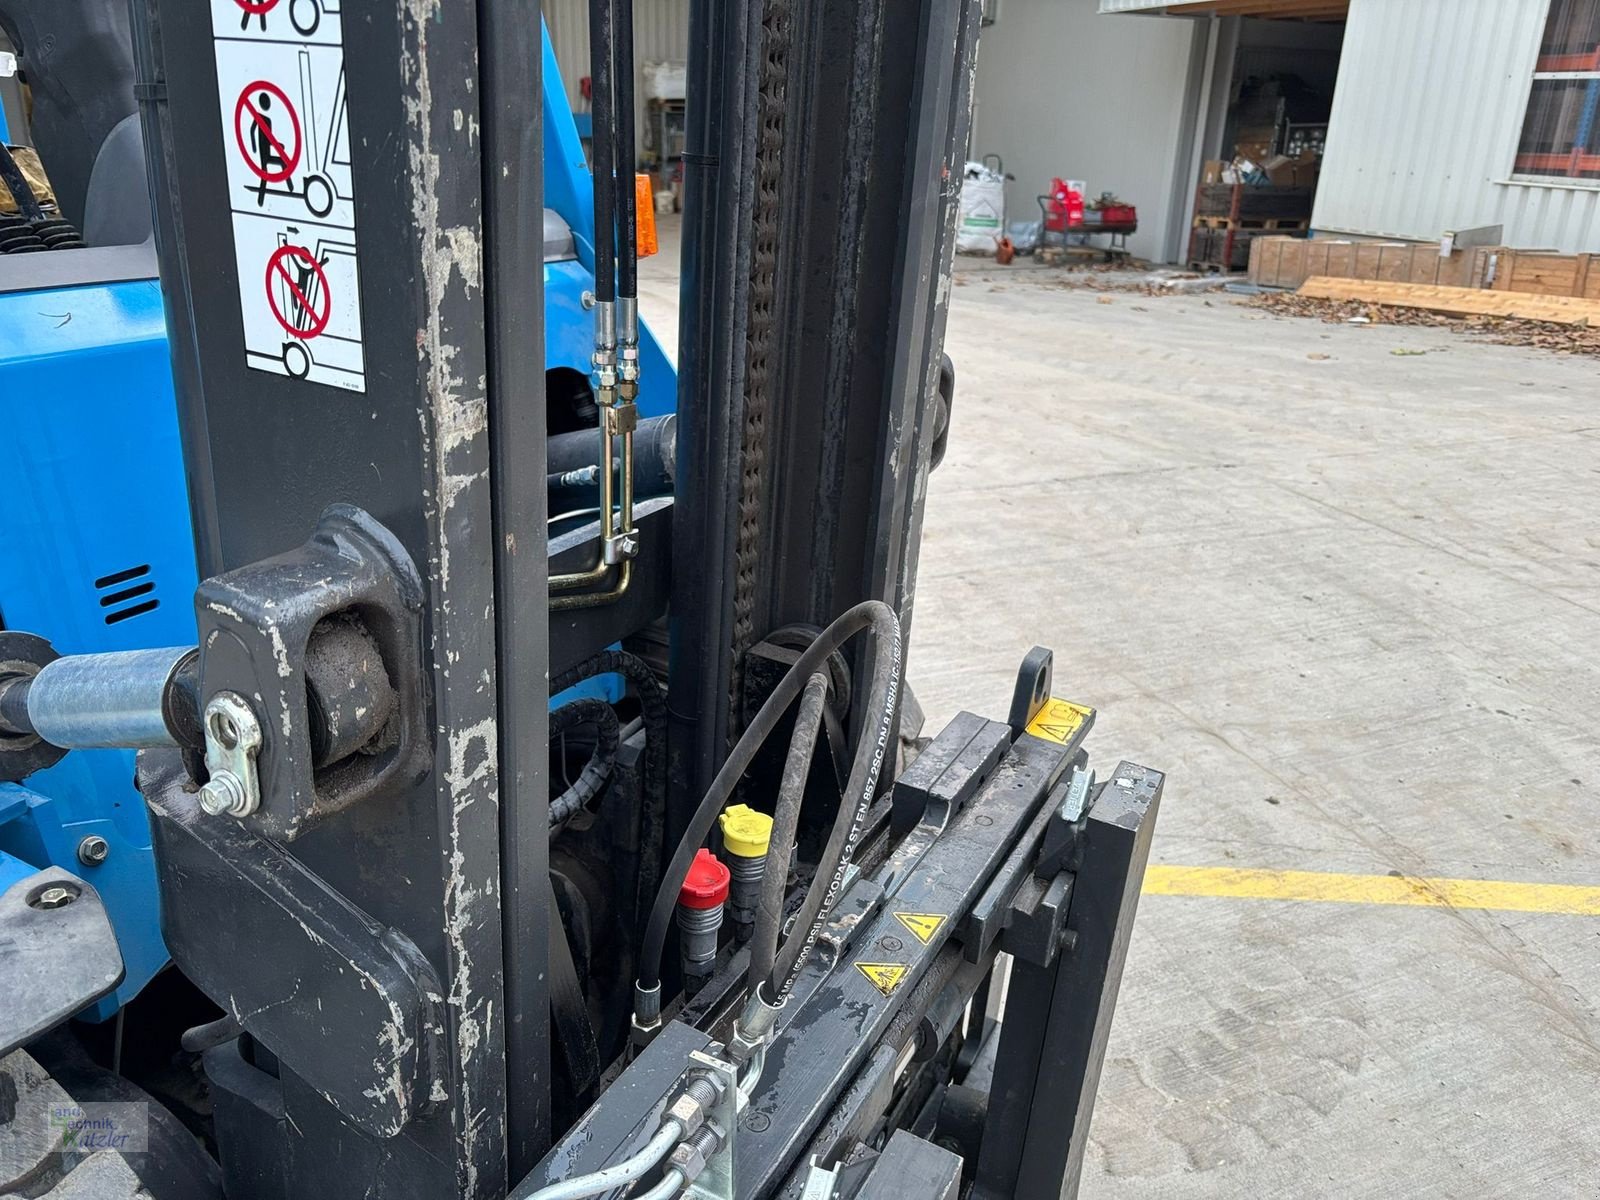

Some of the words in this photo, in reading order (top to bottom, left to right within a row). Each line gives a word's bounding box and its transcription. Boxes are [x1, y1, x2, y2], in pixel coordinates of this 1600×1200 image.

[892, 639, 902, 681] IC-152/7
[885, 680, 898, 717] MSHA
[877, 727, 888, 749] DN
[871, 750, 884, 775] 2SC
[863, 778, 878, 801] 857
[855, 803, 868, 822] EN
[847, 826, 863, 848] ST
[845, 845, 854, 855] 2
[817, 854, 852, 920] FLEXOPAK
